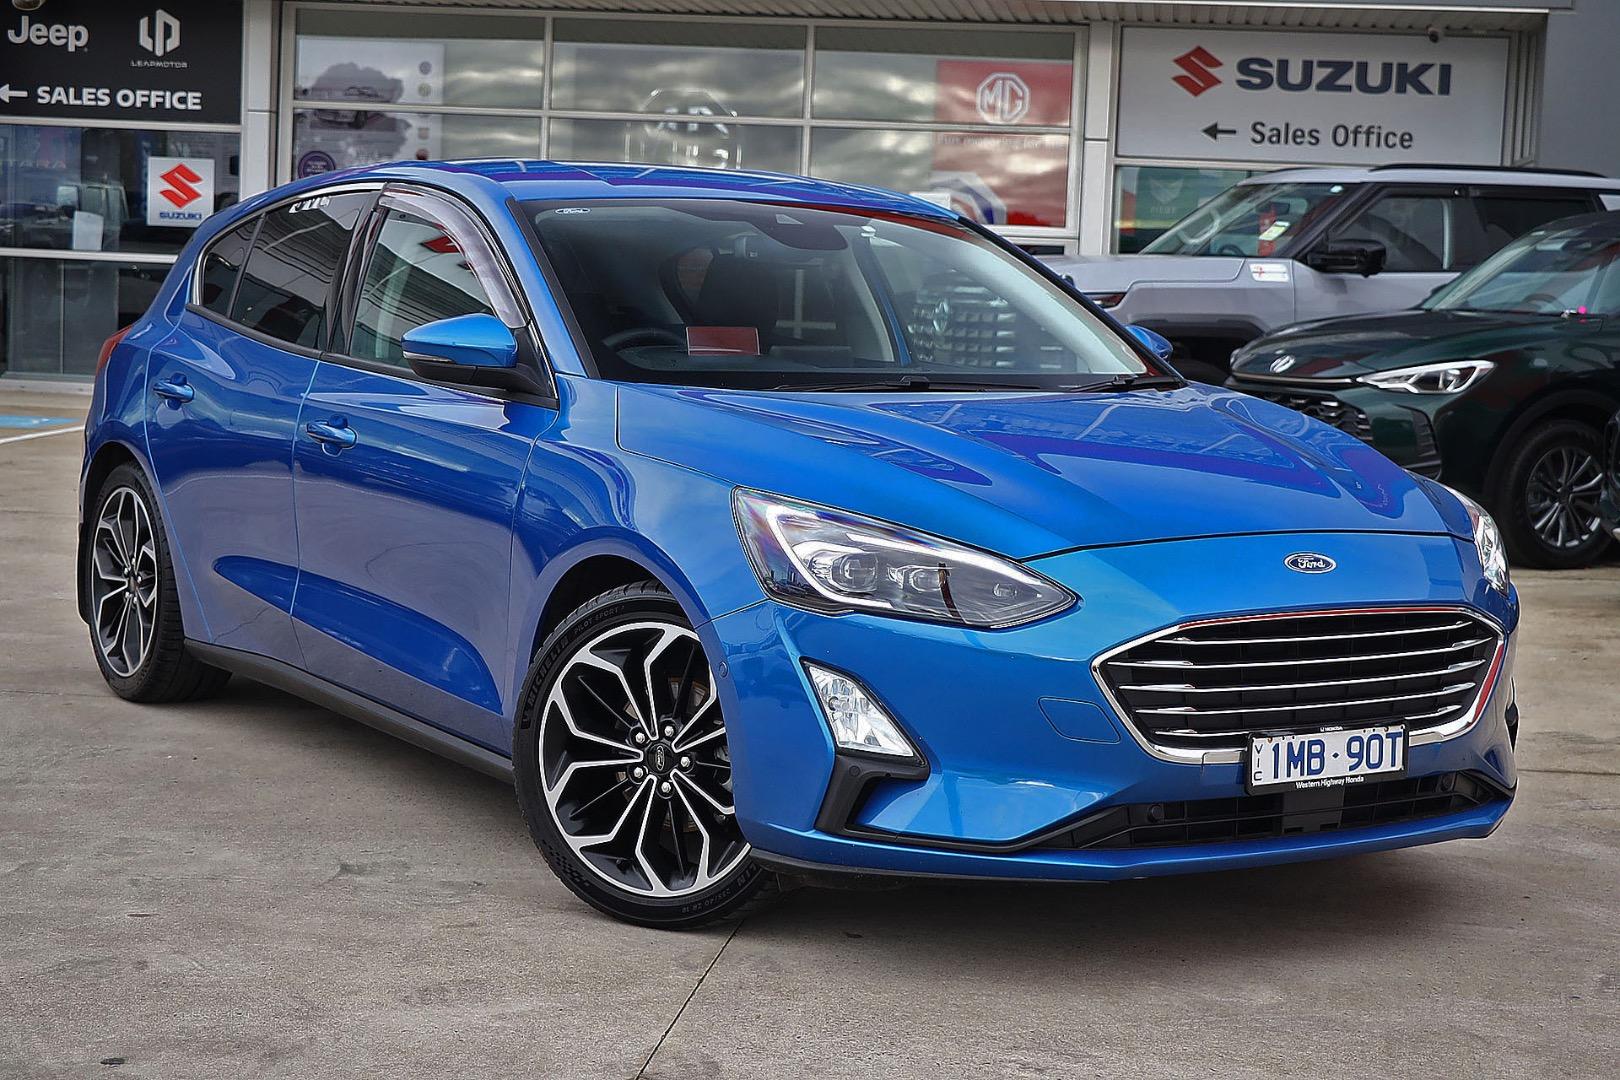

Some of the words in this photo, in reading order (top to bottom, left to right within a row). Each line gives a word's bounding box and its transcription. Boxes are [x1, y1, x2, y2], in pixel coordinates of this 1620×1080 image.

[7, 15, 89, 53] Jeep
[130, 59, 188, 69] LEAPMOTOR
[1235, 56, 1452, 97] SUZUKI
[37, 85, 111, 107] SALES
[116, 89, 202, 111] OFFICE
[981, 77, 1025, 123] MG
[1250, 121, 1320, 146] Sales
[1331, 124, 1414, 149] Office
[159, 211, 202, 222] SUZUKI
[1295, 779, 1320, 789] Western
[1320, 777, 1345, 788] Highway
[1345, 775, 1365, 784] Honda
